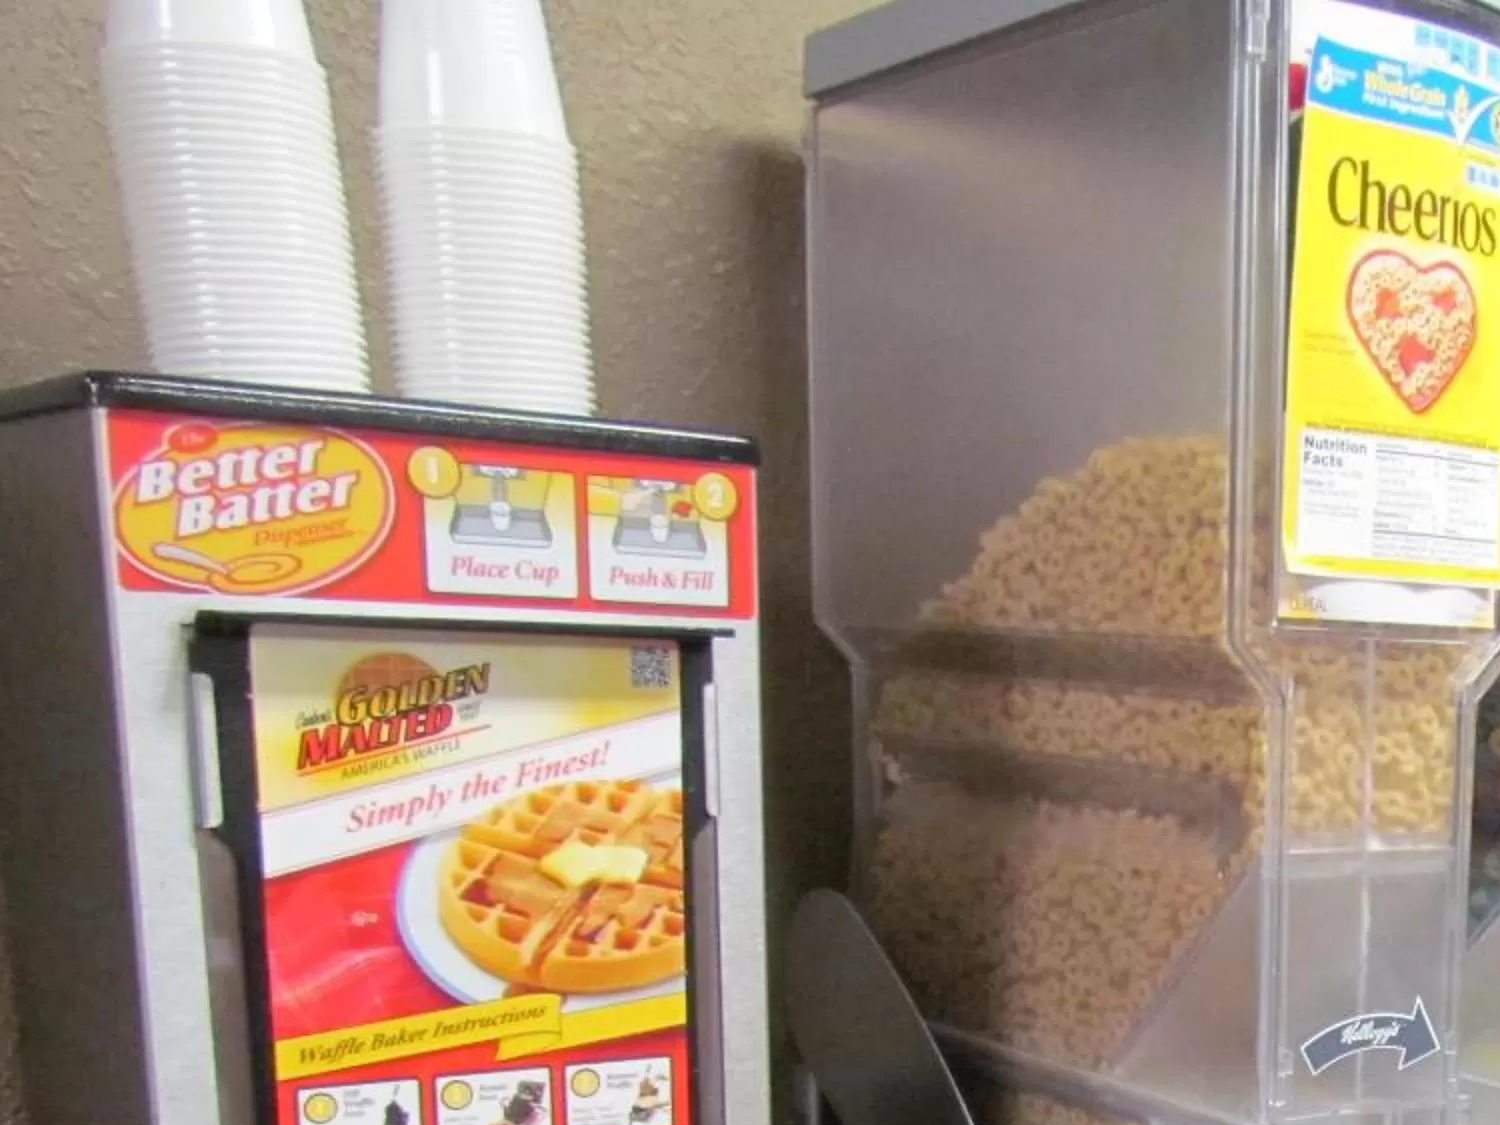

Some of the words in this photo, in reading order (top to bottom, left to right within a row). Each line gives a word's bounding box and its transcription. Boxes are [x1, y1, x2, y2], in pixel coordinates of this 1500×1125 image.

[1328, 155, 1497, 257] Cheerios
[135, 439, 328, 505] Better
[1303, 435, 1368, 457] Nutrition
[1303, 451, 1344, 468] Facts
[175, 470, 361, 540] Batter
[450, 556, 510, 580] Place
[514, 559, 560, 587] Cup
[608, 566, 658, 588] Push
[681, 569, 714, 591] Fill
[336, 662, 492, 726] GOLDEN
[297, 703, 454, 771] MALTED
[346, 783, 453, 834] Simply
[461, 772, 508, 802] the
[515, 740, 612, 789] Finest!
[298, 1036, 367, 1065] Waffle
[370, 1028, 428, 1051] Baker
[432, 1005, 547, 1038] Instructions
